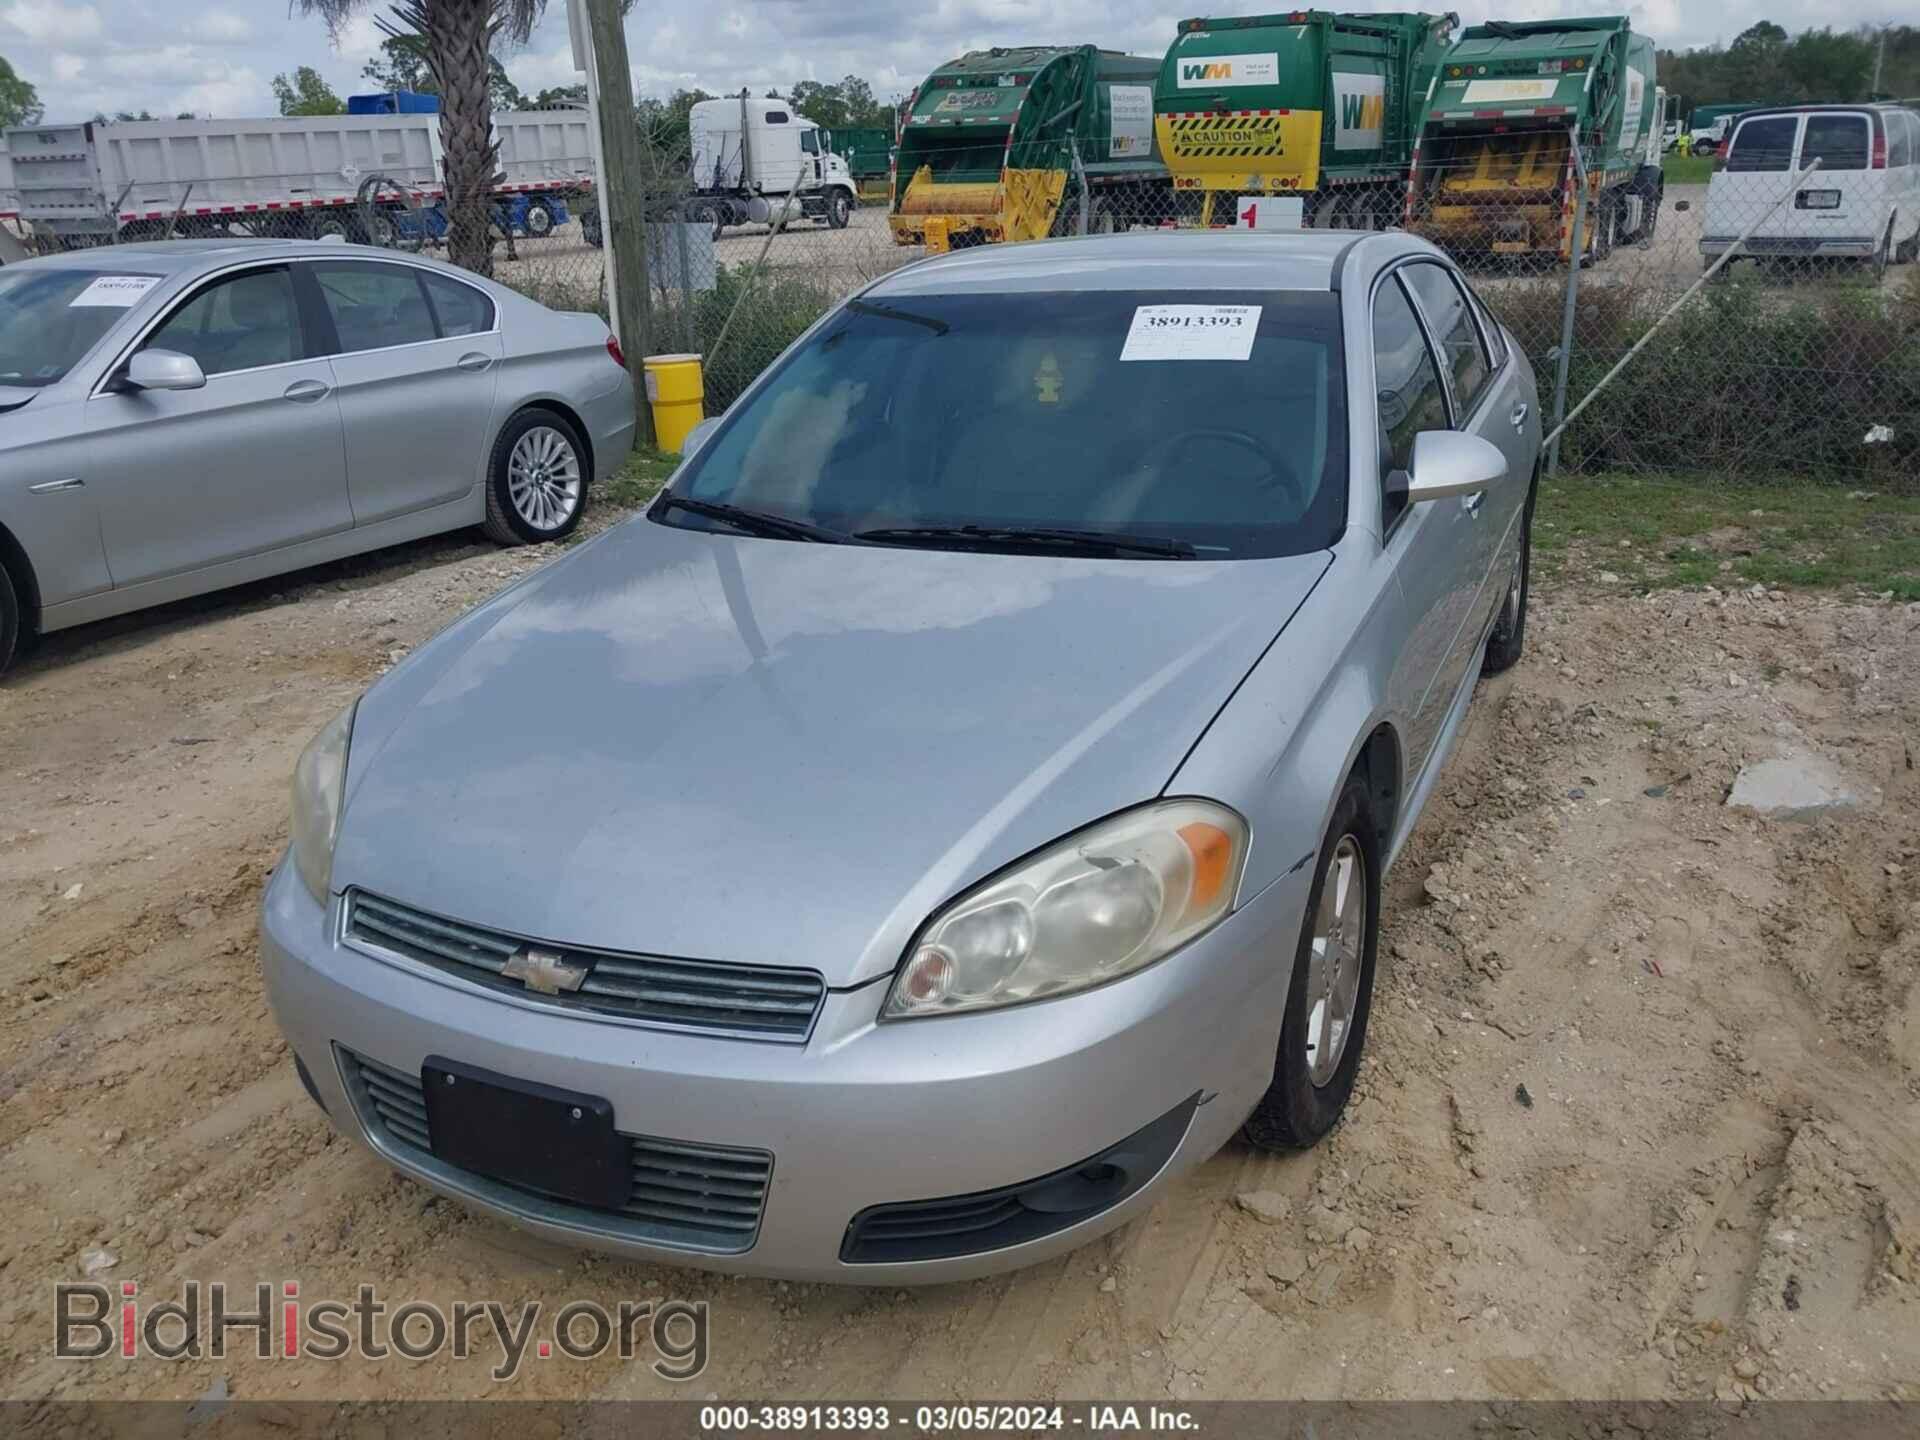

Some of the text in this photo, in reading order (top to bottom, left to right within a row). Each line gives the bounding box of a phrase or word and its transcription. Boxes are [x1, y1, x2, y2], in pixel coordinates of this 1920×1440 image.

[1183, 63, 1232, 80] WM
[1342, 94, 1383, 130] WM
[1194, 130, 1252, 142] CAUTION
[1241, 203, 1257, 228] 1
[1143, 316, 1243, 328] 38913393
